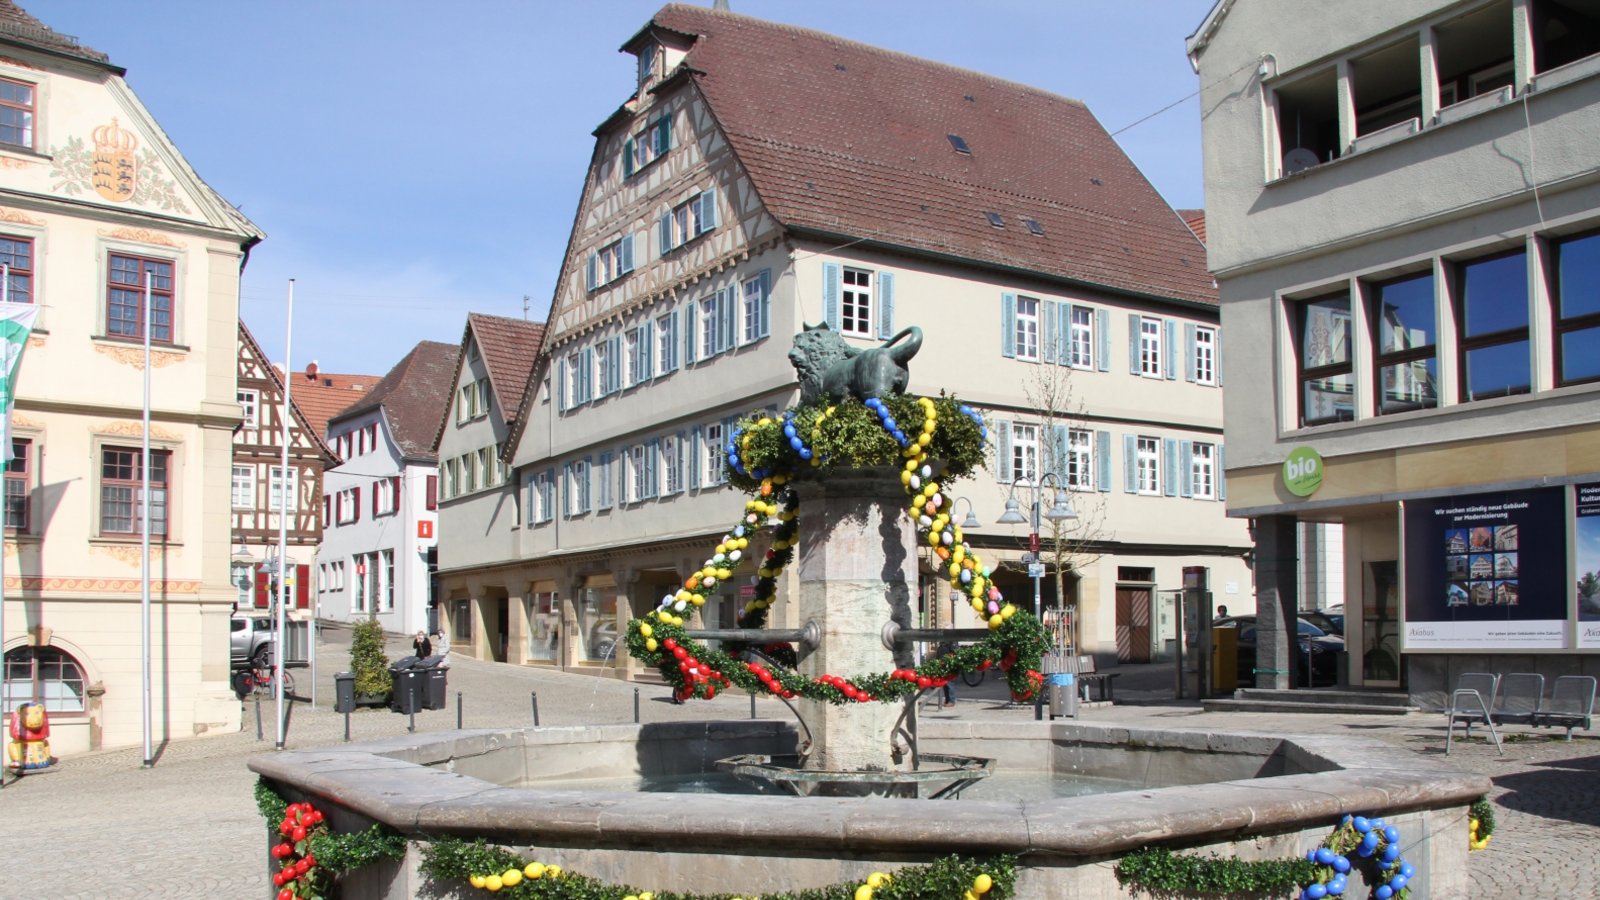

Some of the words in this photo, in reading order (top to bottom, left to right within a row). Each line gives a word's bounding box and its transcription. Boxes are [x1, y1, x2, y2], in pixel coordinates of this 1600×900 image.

[1287, 456, 1316, 480] bio
[1503, 502, 1528, 510] Gebäude
[1464, 512, 1508, 520] Modernisierung
